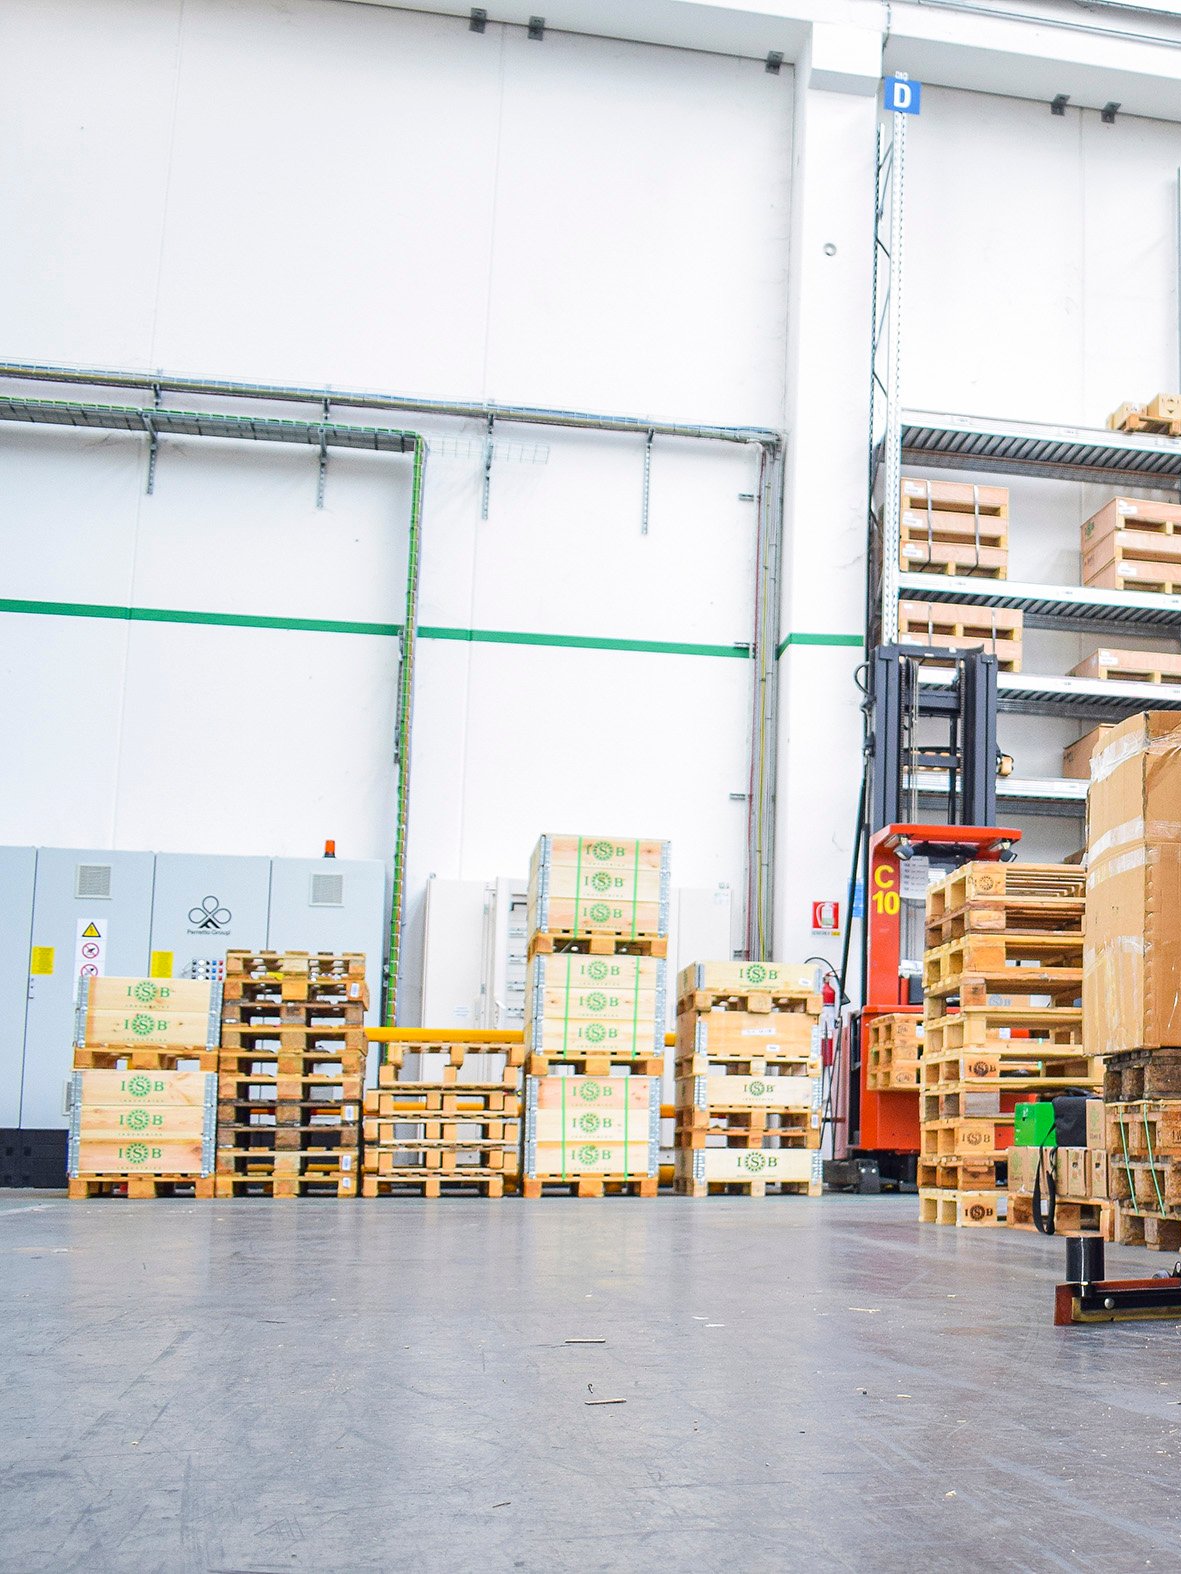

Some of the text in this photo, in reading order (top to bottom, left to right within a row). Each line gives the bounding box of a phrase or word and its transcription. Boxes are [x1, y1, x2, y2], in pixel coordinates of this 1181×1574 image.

[893, 82, 912, 109] D
[874, 864, 895, 888] C
[872, 890, 900, 915] 10
